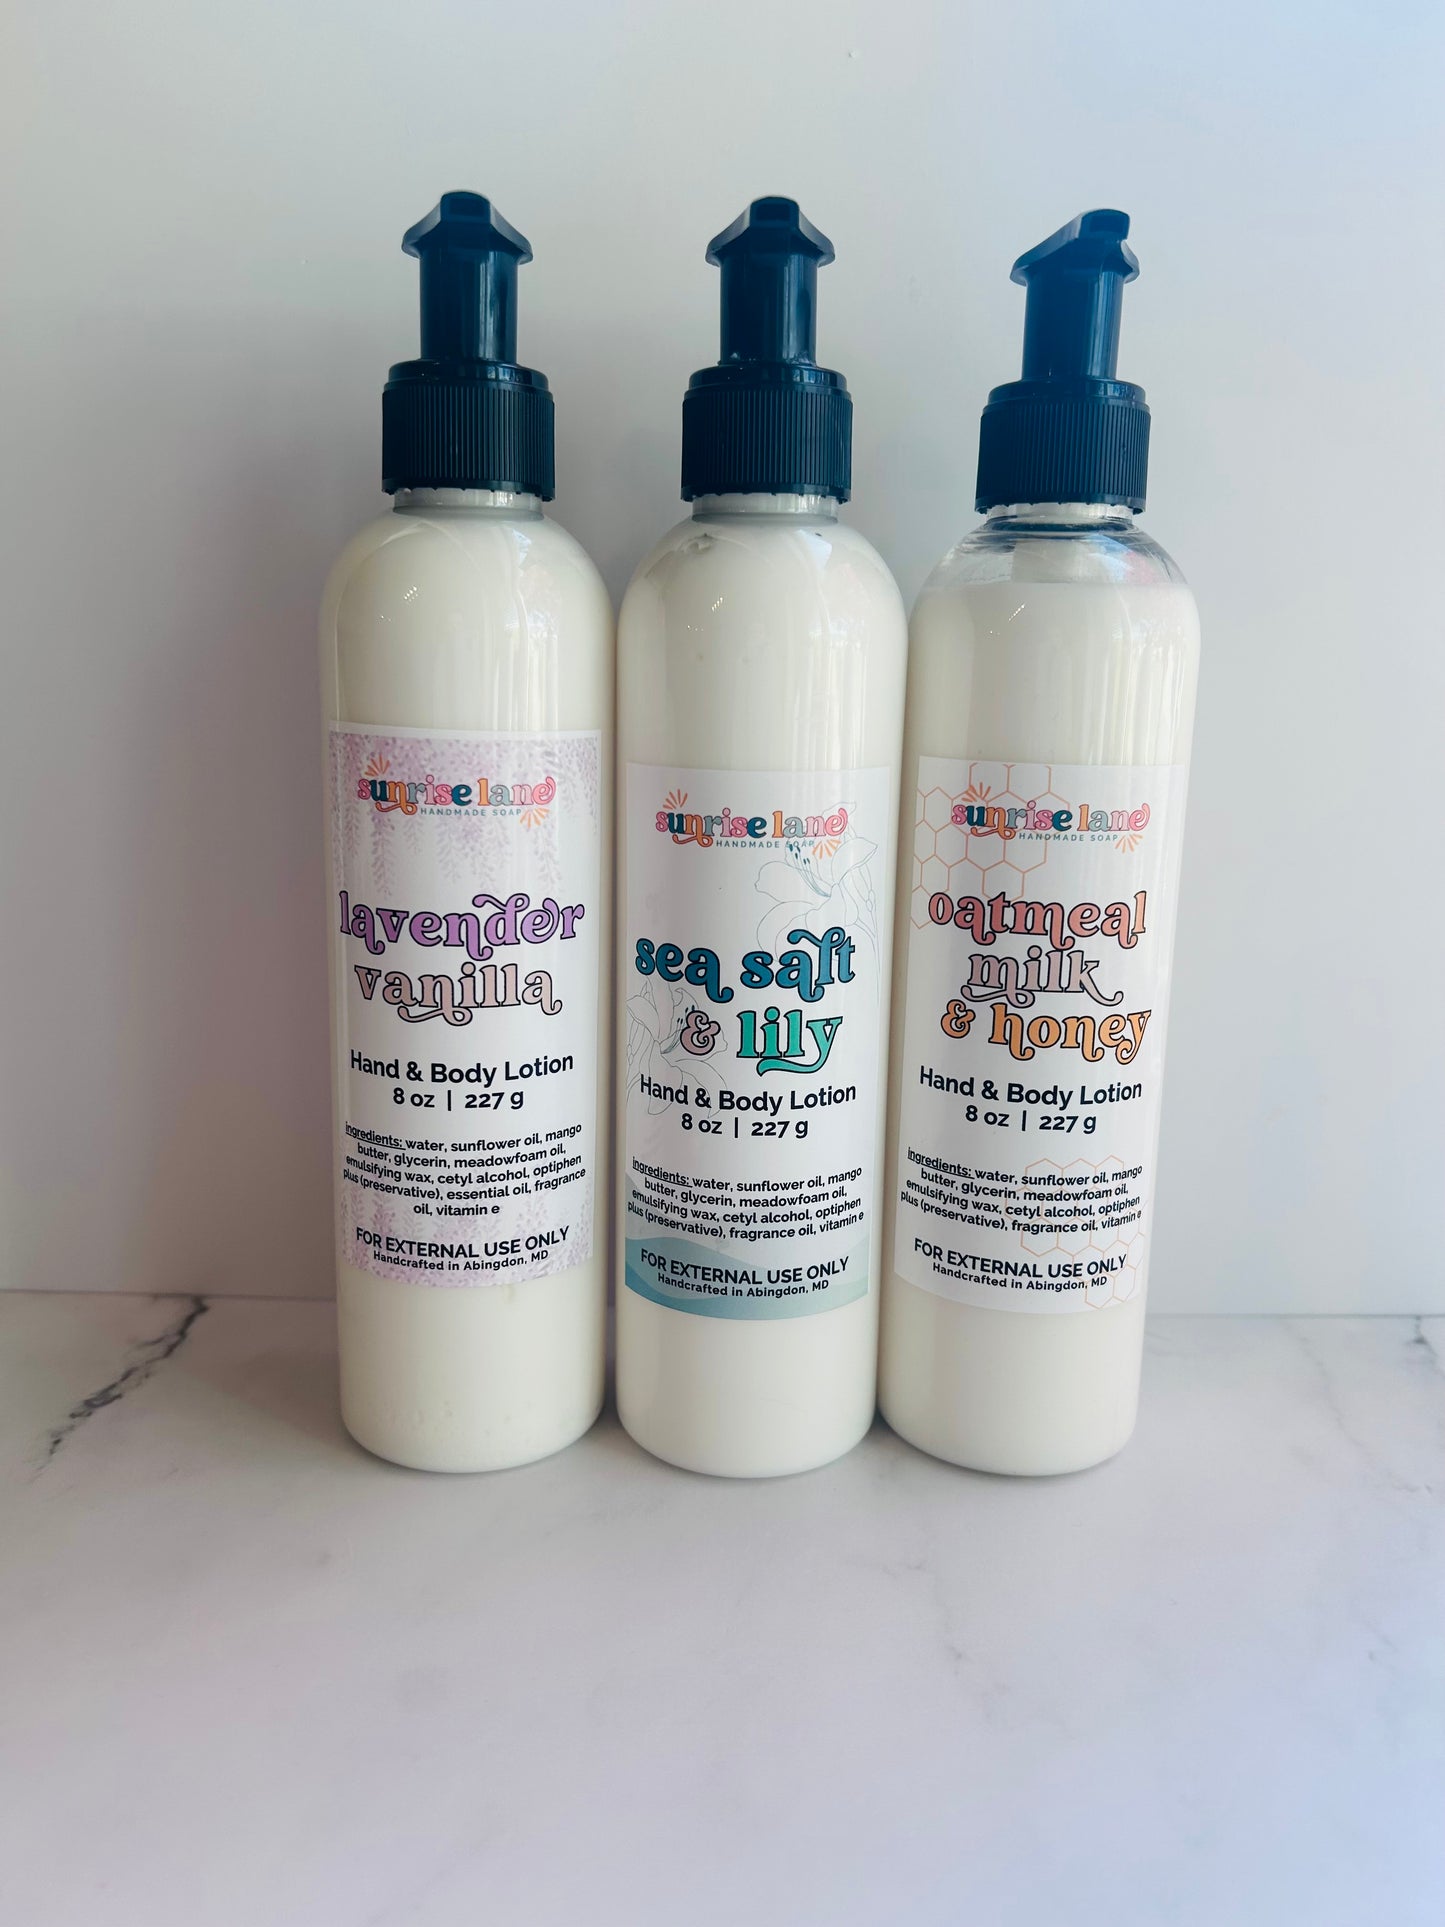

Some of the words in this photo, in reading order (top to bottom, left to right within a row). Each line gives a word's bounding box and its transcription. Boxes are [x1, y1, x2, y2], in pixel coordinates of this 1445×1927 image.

[357, 774, 472, 815] sunrise
[477, 776, 556, 806] lane
[420, 807, 486, 817] HANDMADE
[492, 808, 522, 817] SOAP
[655, 807, 767, 848] sunrise
[771, 807, 848, 839] lane
[951, 800, 1072, 840] sunrise
[1076, 803, 1150, 832] lane
[1018, 832, 1085, 842] HANDMADE
[1090, 833, 1119, 842] SOAP
[716, 839, 780, 849] HANDMADE
[339, 890, 585, 961] lavender
[928, 890, 1147, 951] oatmeal
[635, 937, 734, 1004] sea
[740, 926, 856, 1003] salt
[960, 945, 1124, 1009] milk
[354, 961, 563, 1026] vanilla
[680, 1010, 721, 1056] &
[736, 1006, 843, 1077] lily
[940, 999, 976, 1038] &
[988, 1002, 1152, 1065] honey
[350, 1049, 400, 1080] Hand
[406, 1061, 424, 1082] &
[431, 1062, 497, 1088] Body
[504, 1054, 574, 1081] Lotion
[392, 1087, 405, 1105] 8
[410, 1093, 435, 1108] oz
[464, 1092, 505, 1110] 227
[510, 1090, 524, 1109] g
[640, 1074, 688, 1105] Hand
[694, 1087, 712, 1109] &
[718, 1090, 783, 1116] Body
[790, 1085, 856, 1110] Lotion
[919, 1065, 974, 1097] Hand
[981, 1079, 999, 1101] &
[1006, 1082, 1073, 1111] Body
[1079, 1081, 1142, 1105] Lotion
[345, 1121, 403, 1149] ingredients:
[405, 1140, 448, 1153] water,
[450, 1137, 521, 1152] sunflower
[523, 1133, 542, 1147] oil,
[545, 1123, 582, 1142] mango
[681, 1113, 693, 1130] 8
[698, 1119, 723, 1134] oz
[751, 1121, 790, 1139] 227
[795, 1120, 809, 1139] g
[965, 1105, 978, 1122] 8
[983, 1111, 1010, 1127] oz
[1039, 1115, 1079, 1133] 227
[1083, 1115, 1097, 1134] g
[346, 1155, 402, 1182] emulsifying
[404, 1172, 434, 1185] wax,
[437, 1171, 472, 1187] cetyl
[476, 1167, 530, 1184] alcohol,
[533, 1154, 582, 1181] optiphen
[357, 1142, 391, 1163] butter,
[394, 1153, 450, 1170] glycerin,
[453, 1149, 547, 1169] meadowfoam
[549, 1143, 566, 1157] oil,
[632, 1156, 689, 1186] ingredients:
[692, 1178, 733, 1192] water,
[736, 1178, 805, 1192] sunflower
[807, 1176, 825, 1189] oil,
[827, 1166, 862, 1187] mango
[907, 1146, 971, 1178] ingredients:
[974, 1170, 1018, 1185] water,
[1021, 1173, 1090, 1186] sunflower
[1091, 1172, 1109, 1184] oil,
[1111, 1164, 1143, 1183] mango
[343, 1167, 359, 1185] plus
[359, 1174, 443, 1201] (preservative),
[446, 1186, 509, 1200] essential
[512, 1184, 532, 1196] oil,
[534, 1167, 586, 1192] fragrance
[644, 1177, 678, 1199] butter,
[680, 1189, 736, 1208] glycerin,
[739, 1190, 829, 1208] meadowfoam
[831, 1186, 847, 1198] oil,
[906, 1178, 969, 1210] emulsifying
[971, 1200, 1002, 1215] wax,
[1005, 1204, 1041, 1220] cetyl
[1044, 1204, 1096, 1218] alcohol,
[1098, 1195, 1140, 1216] optiphen
[920, 1168, 958, 1191] butter,
[961, 1181, 1020, 1201] glycerin,
[1023, 1186, 1112, 1201] meadowfoam
[1114, 1184, 1129, 1196] oil,
[413, 1203, 433, 1216] oil,
[436, 1204, 488, 1216] vitamin
[491, 1204, 500, 1214] e
[627, 1200, 644, 1217] plus
[644, 1208, 726, 1239] (preservative),
[729, 1226, 796, 1241] fragrance
[798, 1224, 817, 1236] oil,
[819, 1214, 858, 1233] vitamin
[858, 1211, 864, 1221] e
[631, 1188, 688, 1219] emulsifying
[690, 1208, 720, 1223] wax,
[722, 1211, 757, 1226] cetyl
[760, 1208, 812, 1224] alcohol,
[815, 1197, 861, 1220] optiphen
[900, 1189, 919, 1207] plus
[919, 1199, 1008, 1232] (preservative),
[1011, 1220, 1078, 1235] fragrance
[1080, 1219, 1098, 1232] oil,
[1101, 1212, 1136, 1229] vitamin
[1136, 1209, 1141, 1218] e
[356, 1227, 382, 1248] FOR
[386, 1238, 480, 1258] EXTERNAL
[483, 1239, 521, 1257] USE
[524, 1225, 569, 1251] ONLY
[373, 1251, 444, 1271] Handcrafted
[448, 1261, 460, 1271] in
[463, 1255, 527, 1271] Abingdon,
[530, 1249, 548, 1263] MD
[914, 1238, 943, 1261] FOR
[947, 1251, 1043, 1279] EXTERNAL
[1047, 1262, 1083, 1278] USE
[1086, 1253, 1127, 1275] ONLY
[641, 1248, 667, 1271] FOR
[670, 1259, 763, 1285] EXTERNAL
[767, 1267, 803, 1284] USE
[806, 1256, 849, 1279] ONLY
[932, 1262, 1007, 1288] Handcrafted
[1010, 1278, 1023, 1289] in
[1026, 1279, 1088, 1293] Abingdon,
[1090, 1276, 1107, 1288] MD
[657, 1272, 728, 1296] Handcrafted
[731, 1286, 743, 1297] in
[746, 1284, 809, 1299] Abingdon,
[811, 1279, 829, 1292] MD
